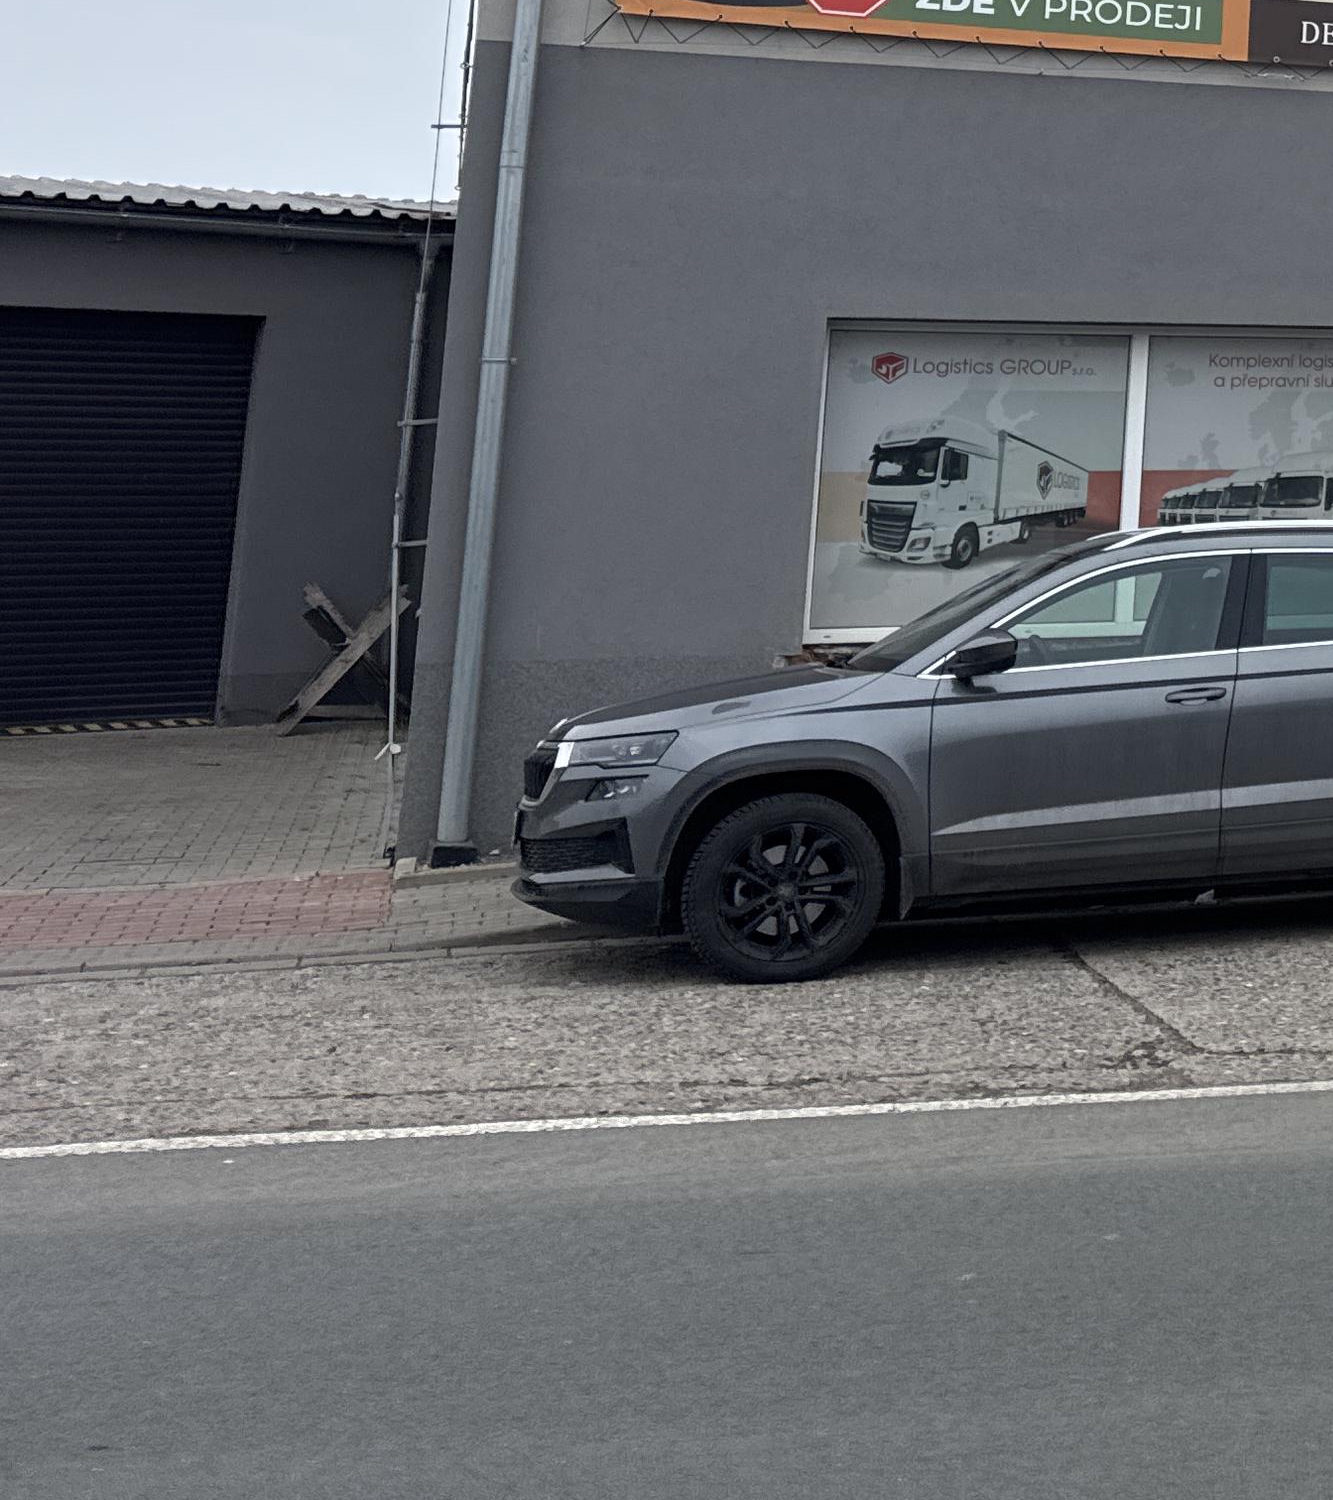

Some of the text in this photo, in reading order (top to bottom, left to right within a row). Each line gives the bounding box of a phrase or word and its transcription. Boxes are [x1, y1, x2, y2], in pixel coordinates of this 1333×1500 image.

[913, 357, 994, 378] Logistics
[1000, 358, 1072, 376] GROUP
[1208, 353, 1295, 370] Komplexní
[1213, 376, 1225, 388] a
[1230, 373, 1310, 390] přepravní
